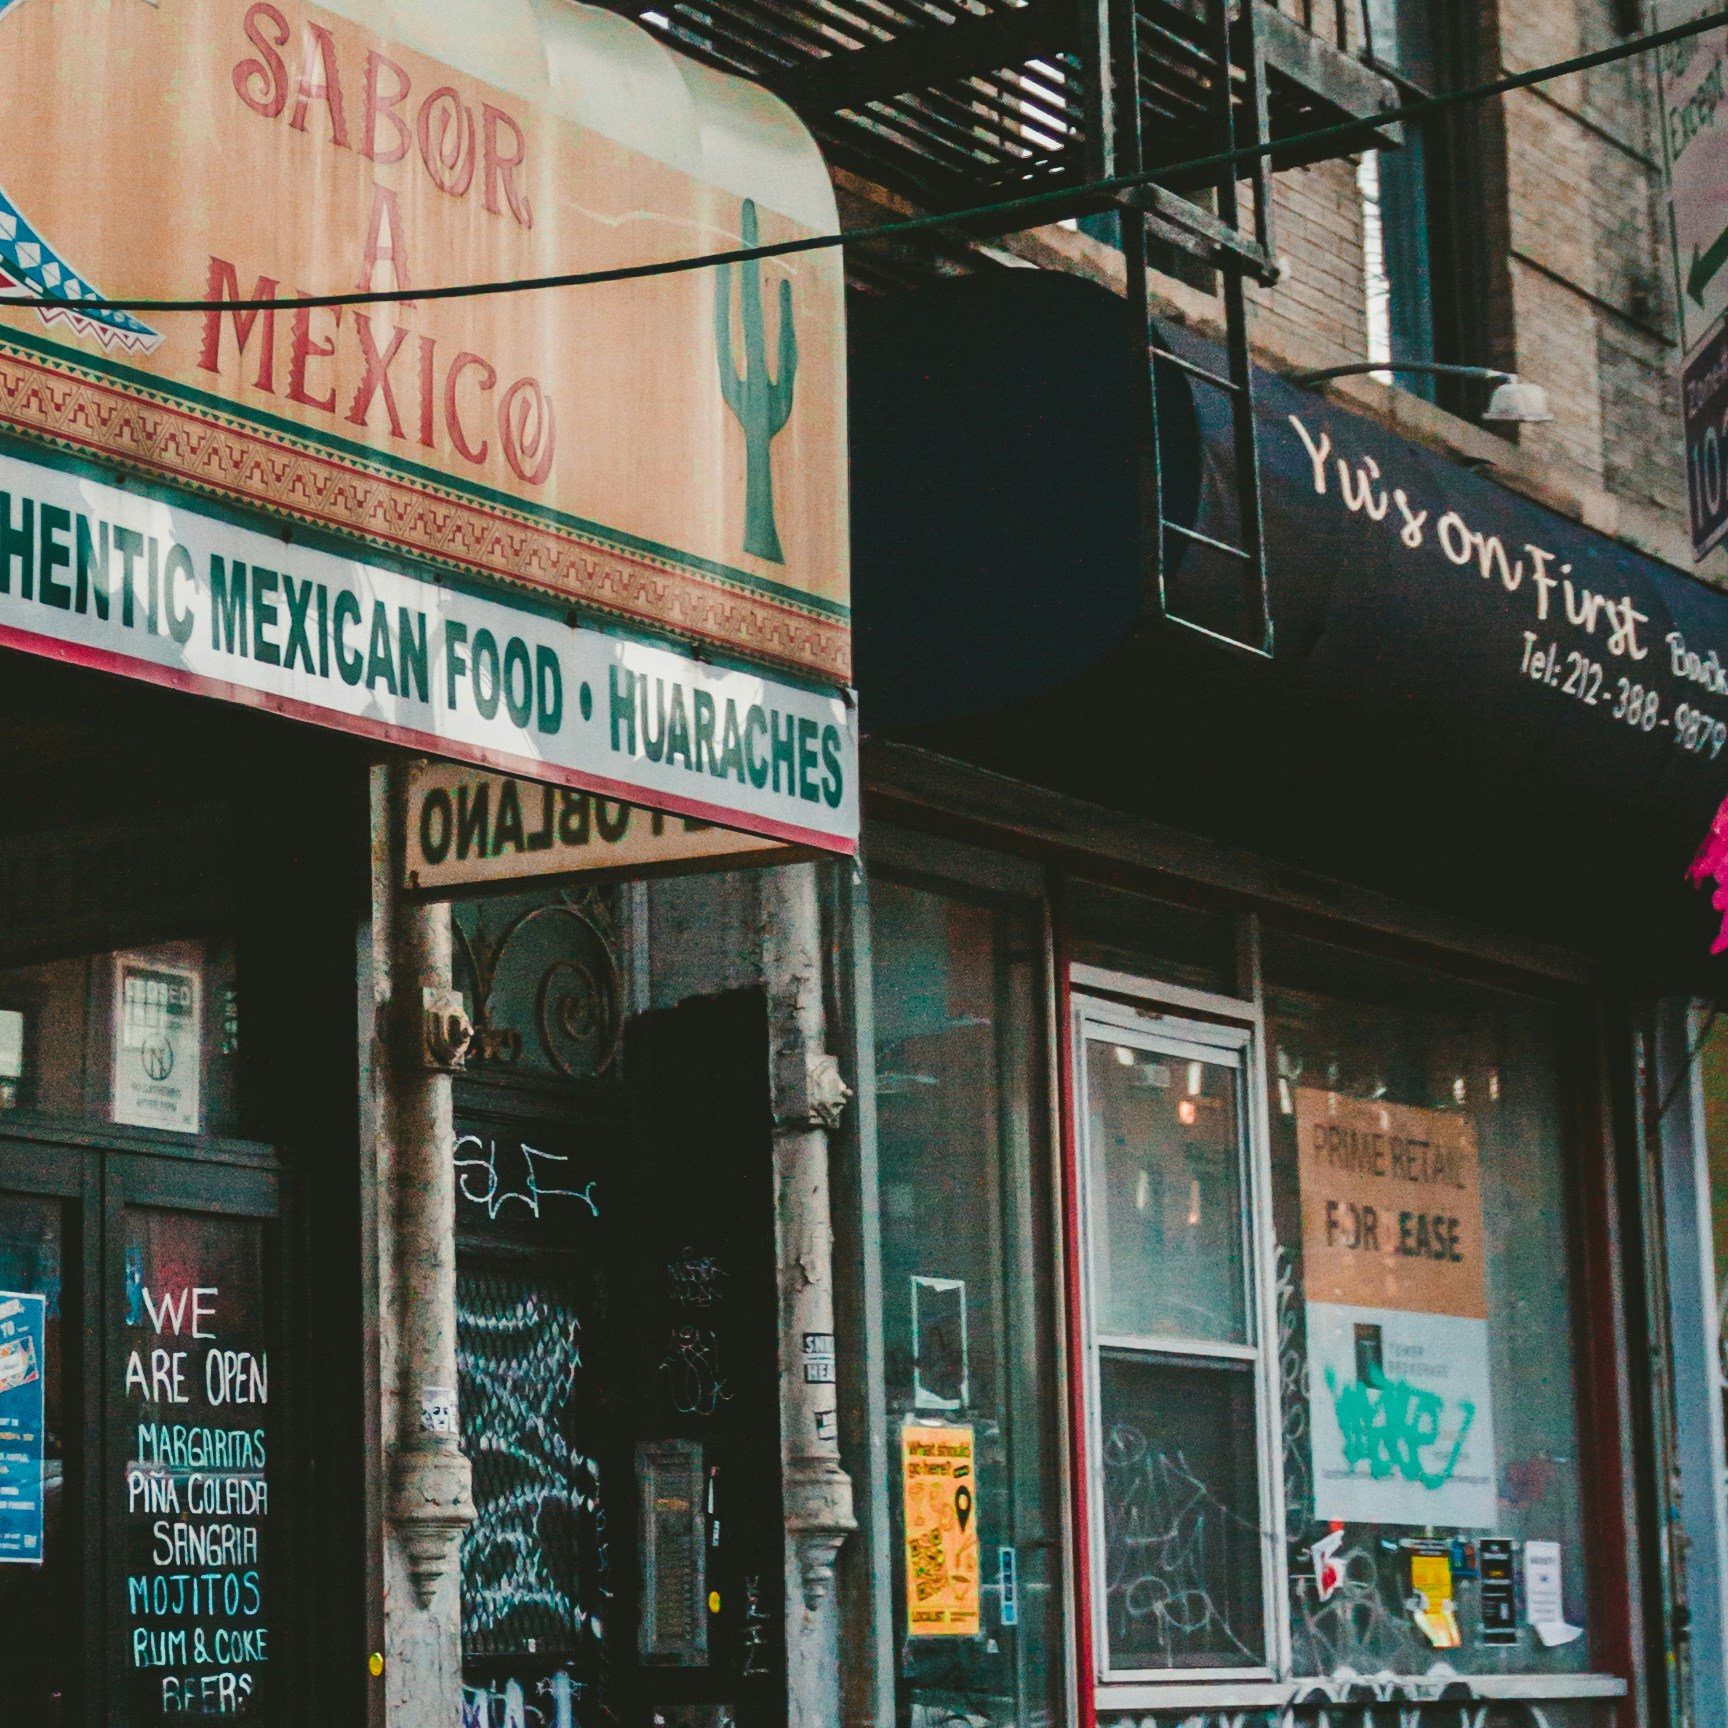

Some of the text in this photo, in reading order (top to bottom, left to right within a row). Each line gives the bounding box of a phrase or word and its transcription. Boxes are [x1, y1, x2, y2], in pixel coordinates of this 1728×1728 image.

[233, 2, 533, 231] SABOR
[359, 182, 413, 309] A
[198, 256, 555, 486] MEXICO
[1524, 544, 1649, 660] First
[211, 554, 430, 706] MEXICAN
[445, 618, 564, 736] FOOD
[610, 663, 844, 809] HUARACHES
[1521, 631, 1728, 760] Tel: 212-388-9879
[1393, 1211, 1463, 1263] EASE
[143, 1287, 218, 1339] WE
[125, 1350, 268, 1406] ARE OPEN
[138, 1424, 265, 1468] MARGARITAS
[188, 1473, 268, 1516] COLADA
[153, 1521, 258, 1566] SANGRIA
[129, 1571, 260, 1615] MOJITOS
[133, 1628, 269, 1667] RUM & COKE
